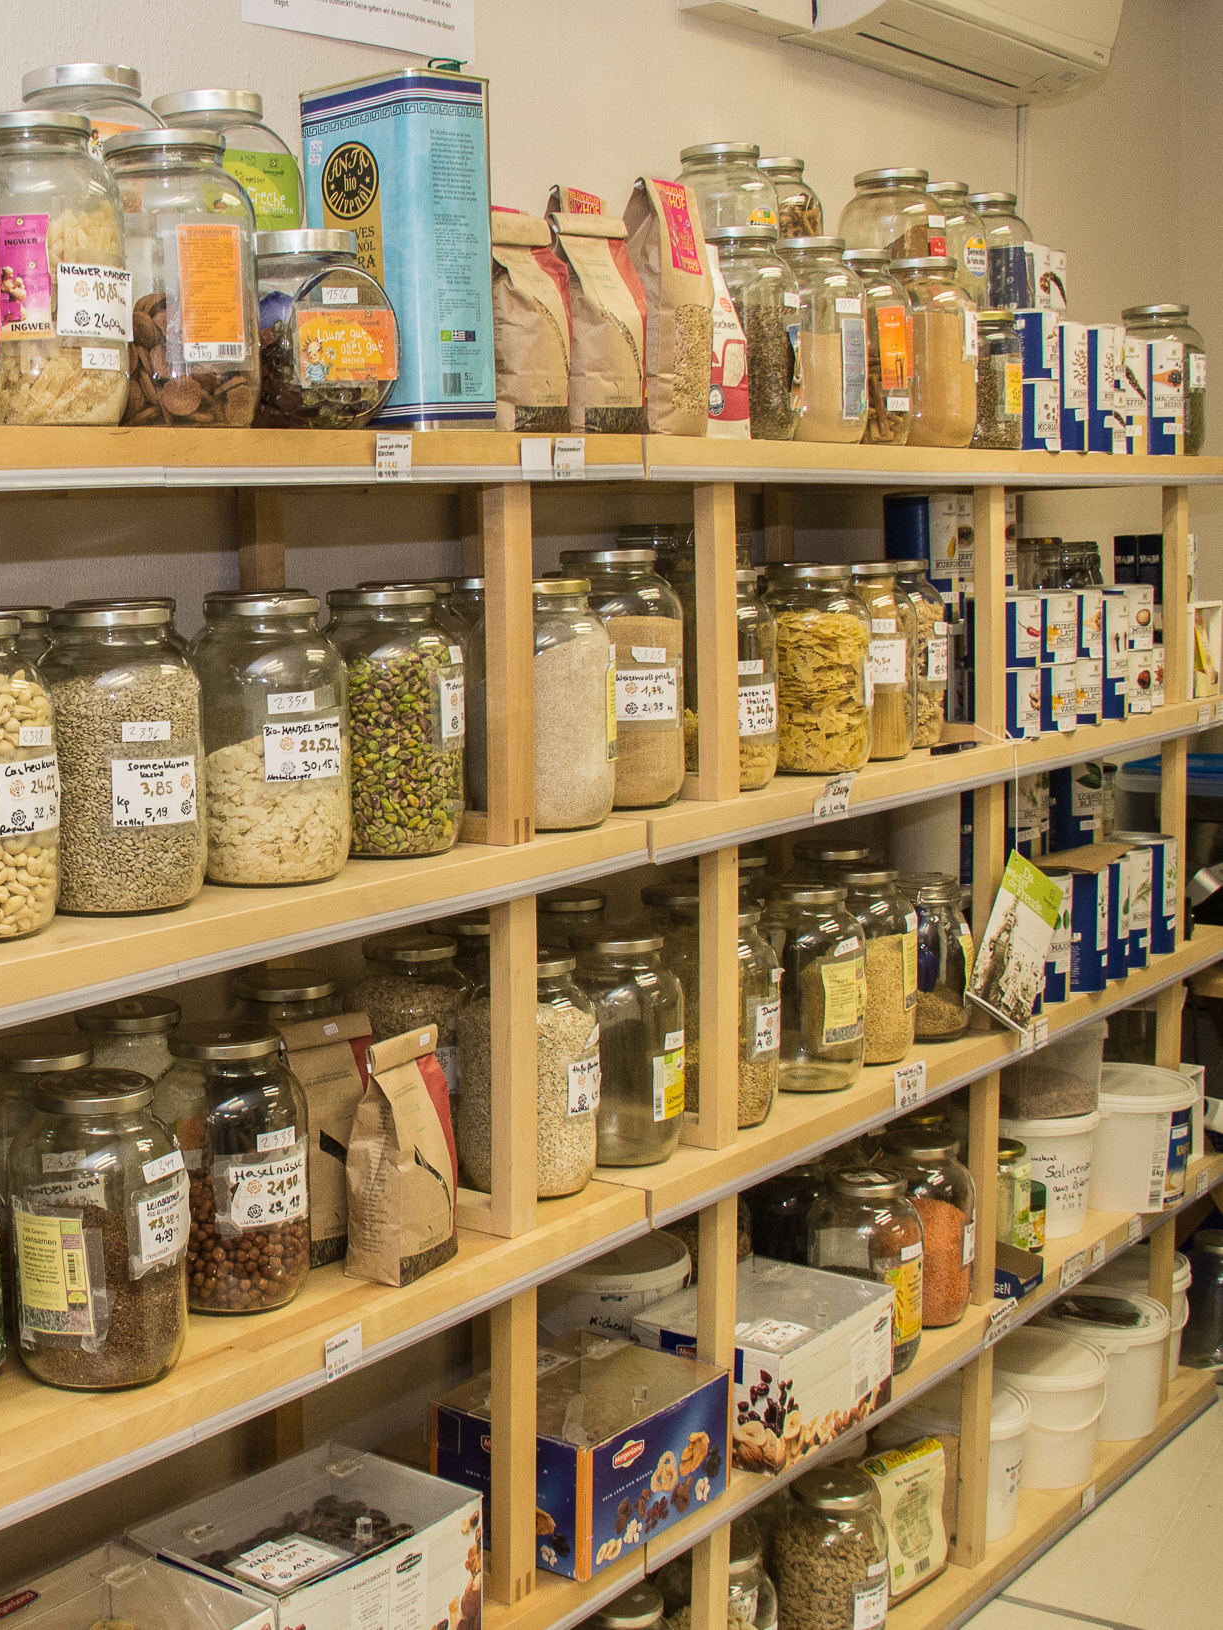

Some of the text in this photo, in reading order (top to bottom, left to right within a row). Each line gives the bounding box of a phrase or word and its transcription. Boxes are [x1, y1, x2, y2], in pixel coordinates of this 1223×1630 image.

[344, 175, 357, 192] bio
[247, 187, 286, 207] Freche
[329, 184, 373, 214] olivenöl
[327, 288, 349, 300] 1526
[11, 323, 50, 332] INGWER
[714, 320, 737, 330] ocken
[317, 329, 345, 342] Laune
[340, 341, 362, 355] alles
[282, 724, 313, 735] MANDEL
[302, 759, 332, 771] 30,15
[140, 781, 173, 797] 3,85
[145, 807, 168, 822] 5,19
[234, 1159, 303, 1182] Haselnüsse
[22, 1234, 56, 1246] Leinsamen
[614, 1441, 644, 1464] Morgenland
